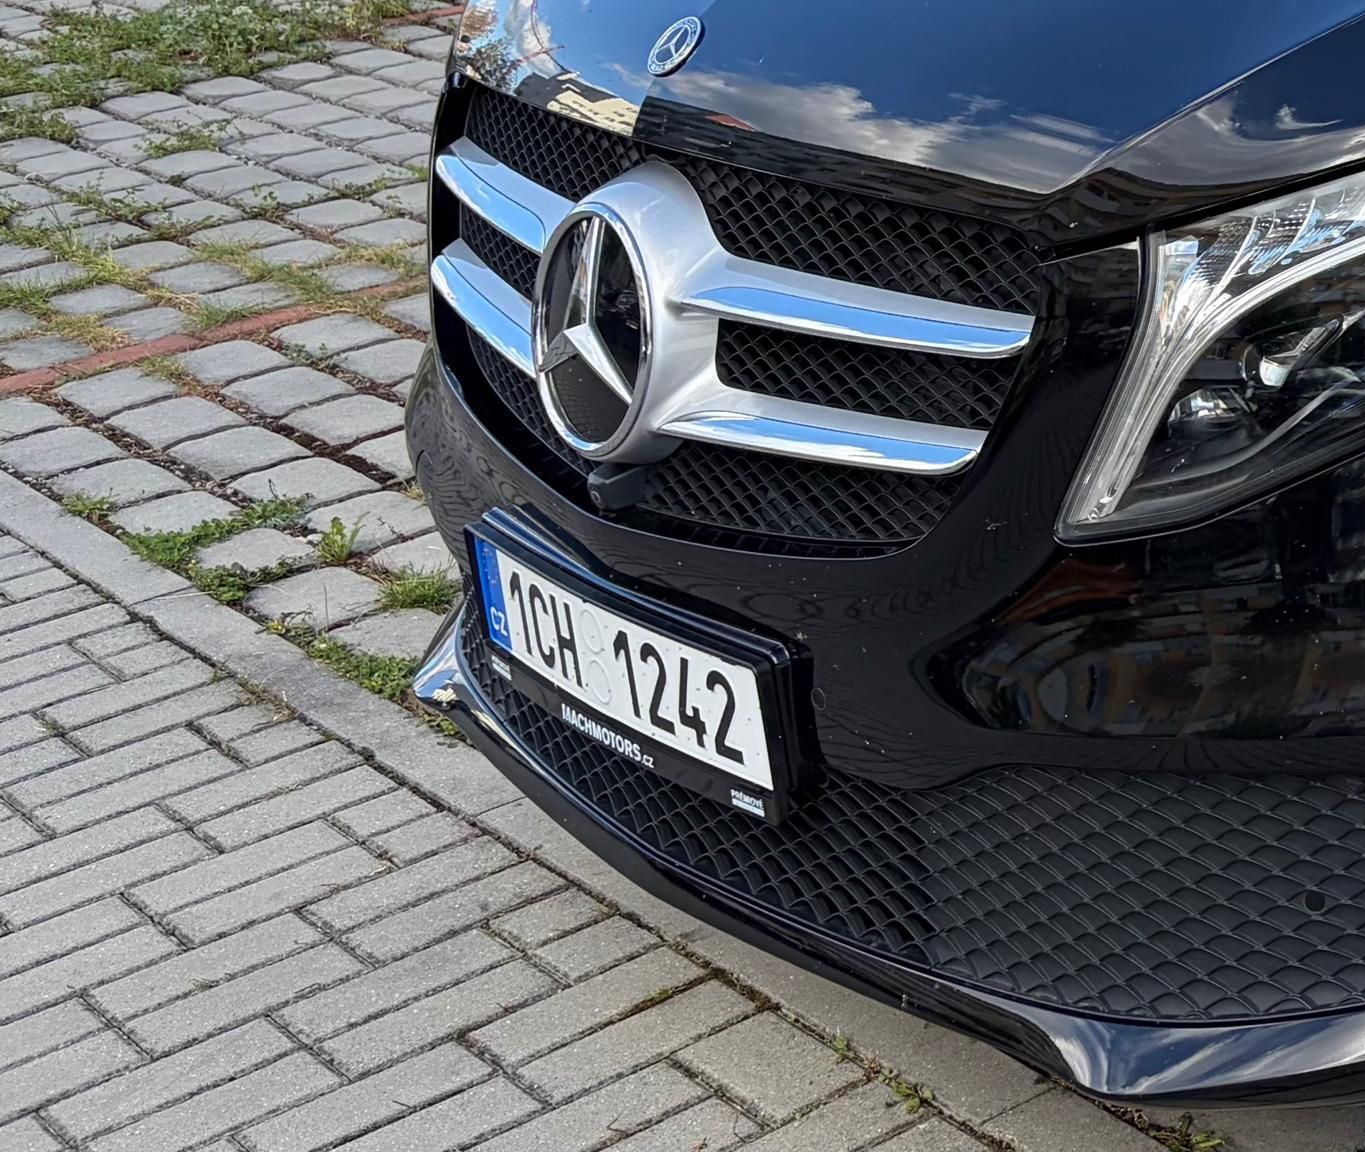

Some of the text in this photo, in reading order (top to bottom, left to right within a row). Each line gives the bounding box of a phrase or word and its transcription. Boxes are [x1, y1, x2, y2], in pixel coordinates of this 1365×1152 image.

[490, 606, 508, 636] CZ
[510, 571, 745, 766] 1CH 1242
